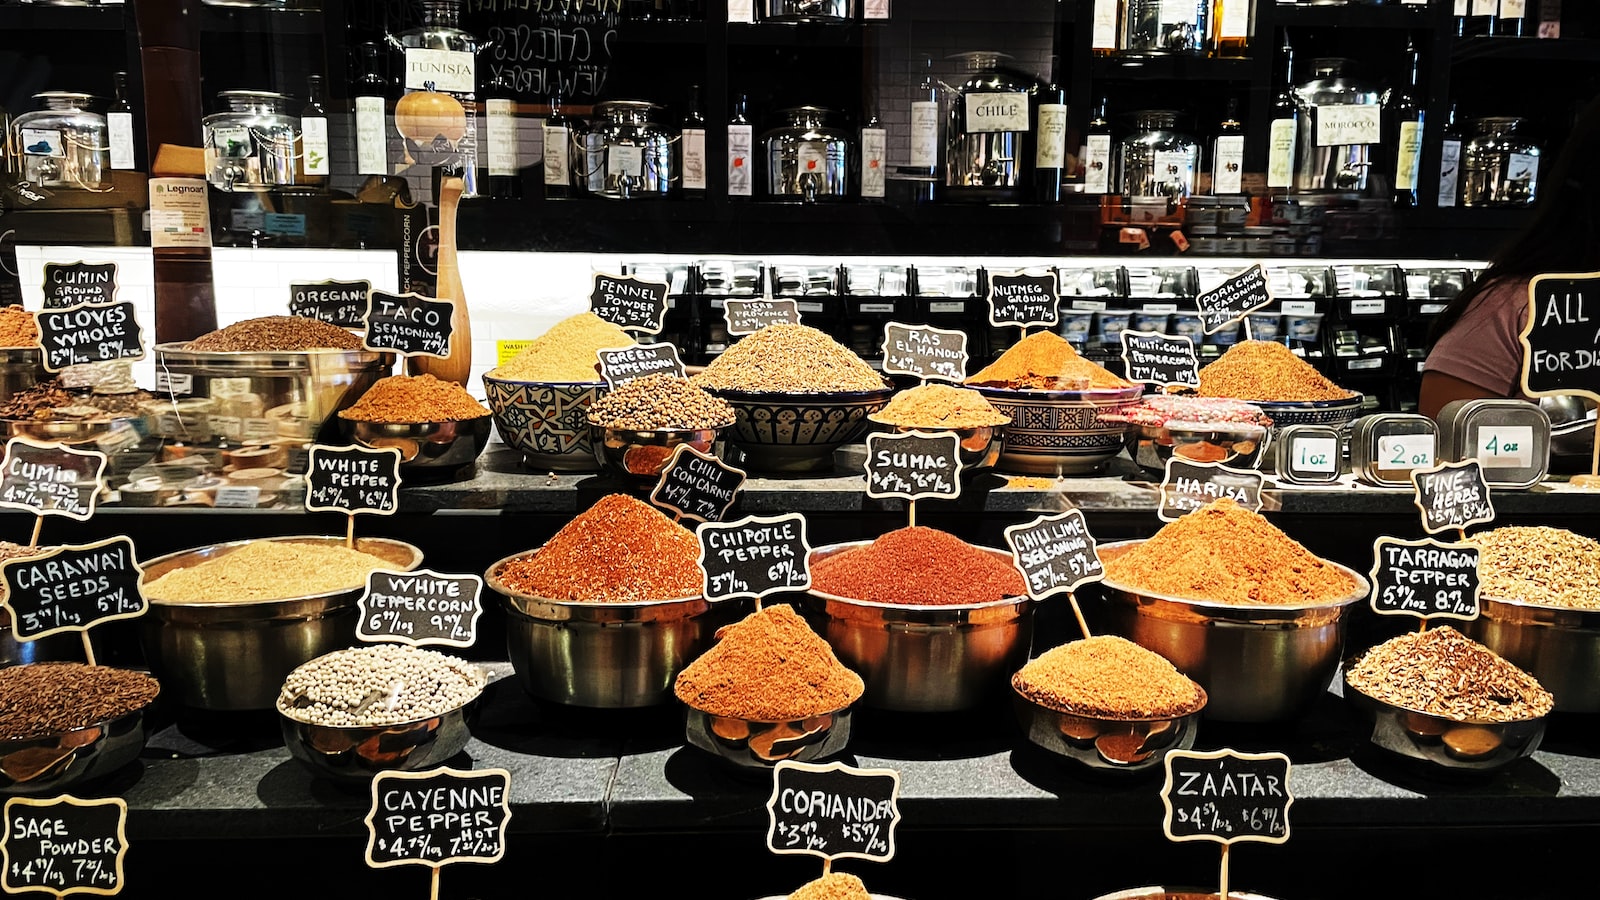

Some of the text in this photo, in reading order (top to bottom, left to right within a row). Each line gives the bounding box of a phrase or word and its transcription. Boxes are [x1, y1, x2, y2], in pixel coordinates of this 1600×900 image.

[409, 62, 471, 75] TUNISIA
[976, 105, 1018, 117] CHILE
[1324, 120, 1375, 129] MOROCCO
[403, 214, 411, 276] PEPPERCORN
[53, 269, 109, 284] CUMIN
[55, 286, 102, 296] GROUND
[295, 290, 367, 303] OREGANO
[600, 279, 657, 301] FENNEL
[994, 284, 1042, 297] NUTMEG
[1007, 294, 1050, 303] GROUND
[1203, 269, 1261, 307] PORK CHOP
[380, 300, 440, 326] TACO
[604, 293, 654, 312] POWDER
[1541, 293, 1590, 327] ALL
[48, 305, 127, 331] CLOVES
[53, 323, 125, 347] WHOLE
[909, 330, 941, 346] RAS
[606, 349, 657, 364] GREEN
[895, 340, 964, 359] EL HANOUT
[1131, 350, 1194, 366] PEPPERCORN
[607, 358, 675, 376] PEPPERCORN
[1533, 349, 1574, 373] FOR
[1301, 447, 1306, 465] 1
[1390, 444, 1406, 464] 2
[1485, 435, 1499, 456] 4
[318, 458, 379, 474] WHITE
[689, 458, 723, 482] CHILI
[876, 449, 948, 470] SUMAC
[26, 481, 80, 499] SEEDS
[331, 473, 389, 487] PEPPER
[672, 466, 733, 501] CON CARNE
[1175, 476, 1248, 503] HARISA
[1425, 470, 1465, 495] FINE
[1432, 486, 1480, 509] HERBS
[709, 523, 796, 548] CHIPOTLE
[1014, 517, 1084, 552] CHILI LIME
[718, 544, 795, 564] PEPPER
[1021, 537, 1087, 569] SEASONING
[1385, 547, 1478, 569] TARRAGON
[16, 548, 124, 590] CARAWAY
[1389, 566, 1470, 587] PEPPER
[39, 575, 110, 605] SEEDS
[388, 577, 460, 597] WHITE
[369, 592, 473, 612] PEPPERCORN
[384, 786, 503, 811] CAYENNE
[781, 788, 894, 822] CORIANDER
[14, 817, 69, 839] SAGE
[385, 811, 493, 833] PEPPER
[461, 826, 499, 842] HOT
[40, 837, 117, 856] POWDER
